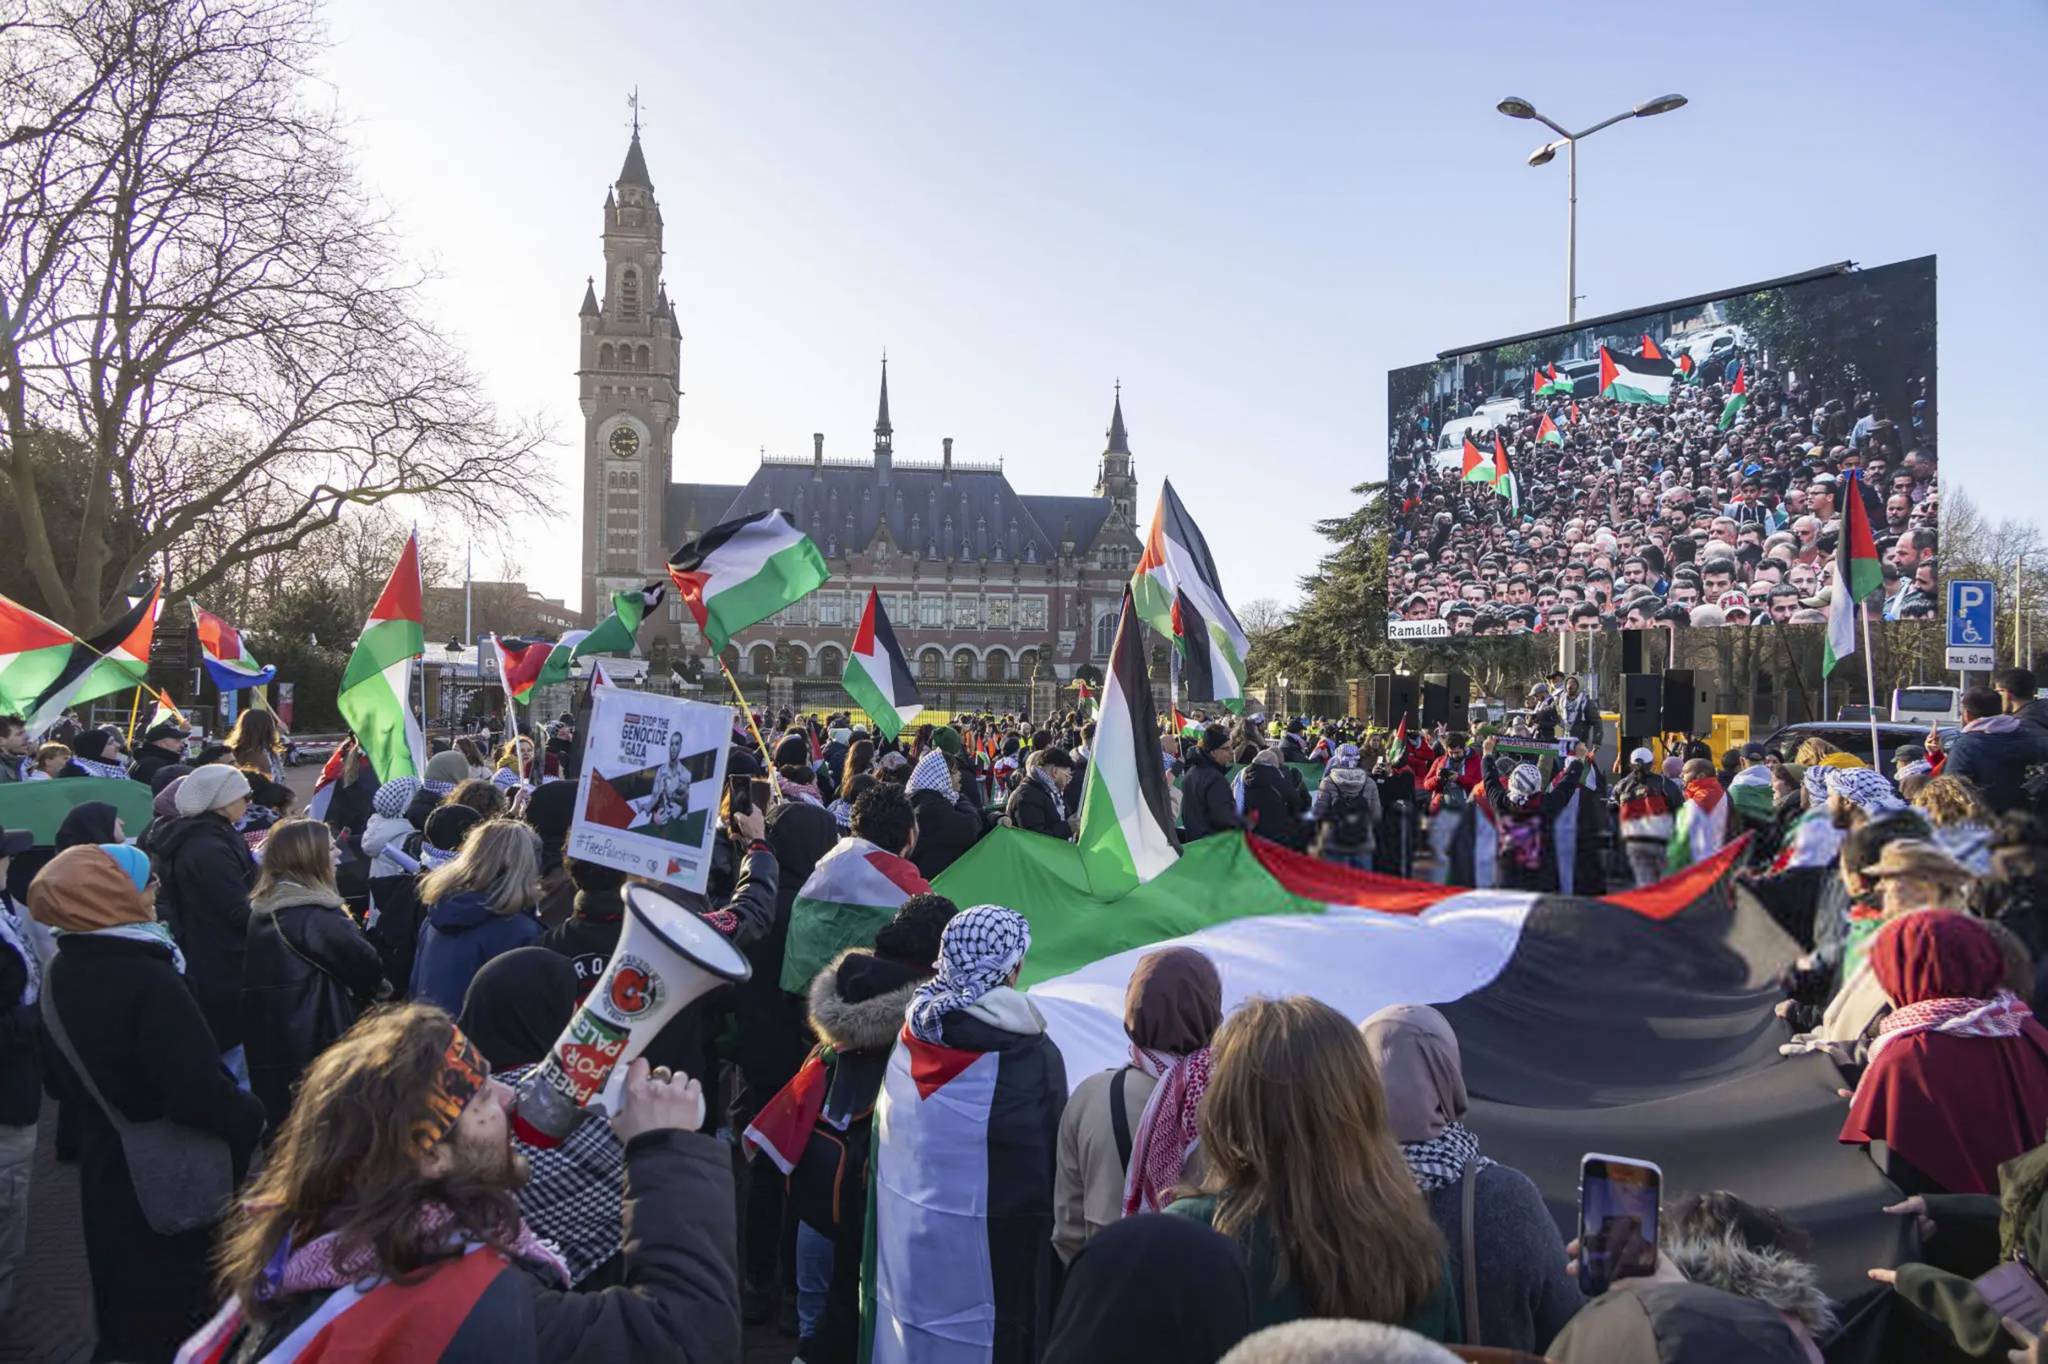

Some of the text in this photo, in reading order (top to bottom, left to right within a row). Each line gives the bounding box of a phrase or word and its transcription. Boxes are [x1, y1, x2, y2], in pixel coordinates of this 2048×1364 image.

[1960, 586, 1984, 617] P
[1389, 624, 1445, 637] Ramallah
[1949, 656, 1965, 664] max.
[1968, 655, 1978, 664] 60
[641, 715, 657, 726] STOP
[658, 717, 670, 729] THE
[622, 724, 668, 746] GENOCIDE
[625, 741, 647, 758] GAZA
[566, 1047, 613, 1080] FOR
